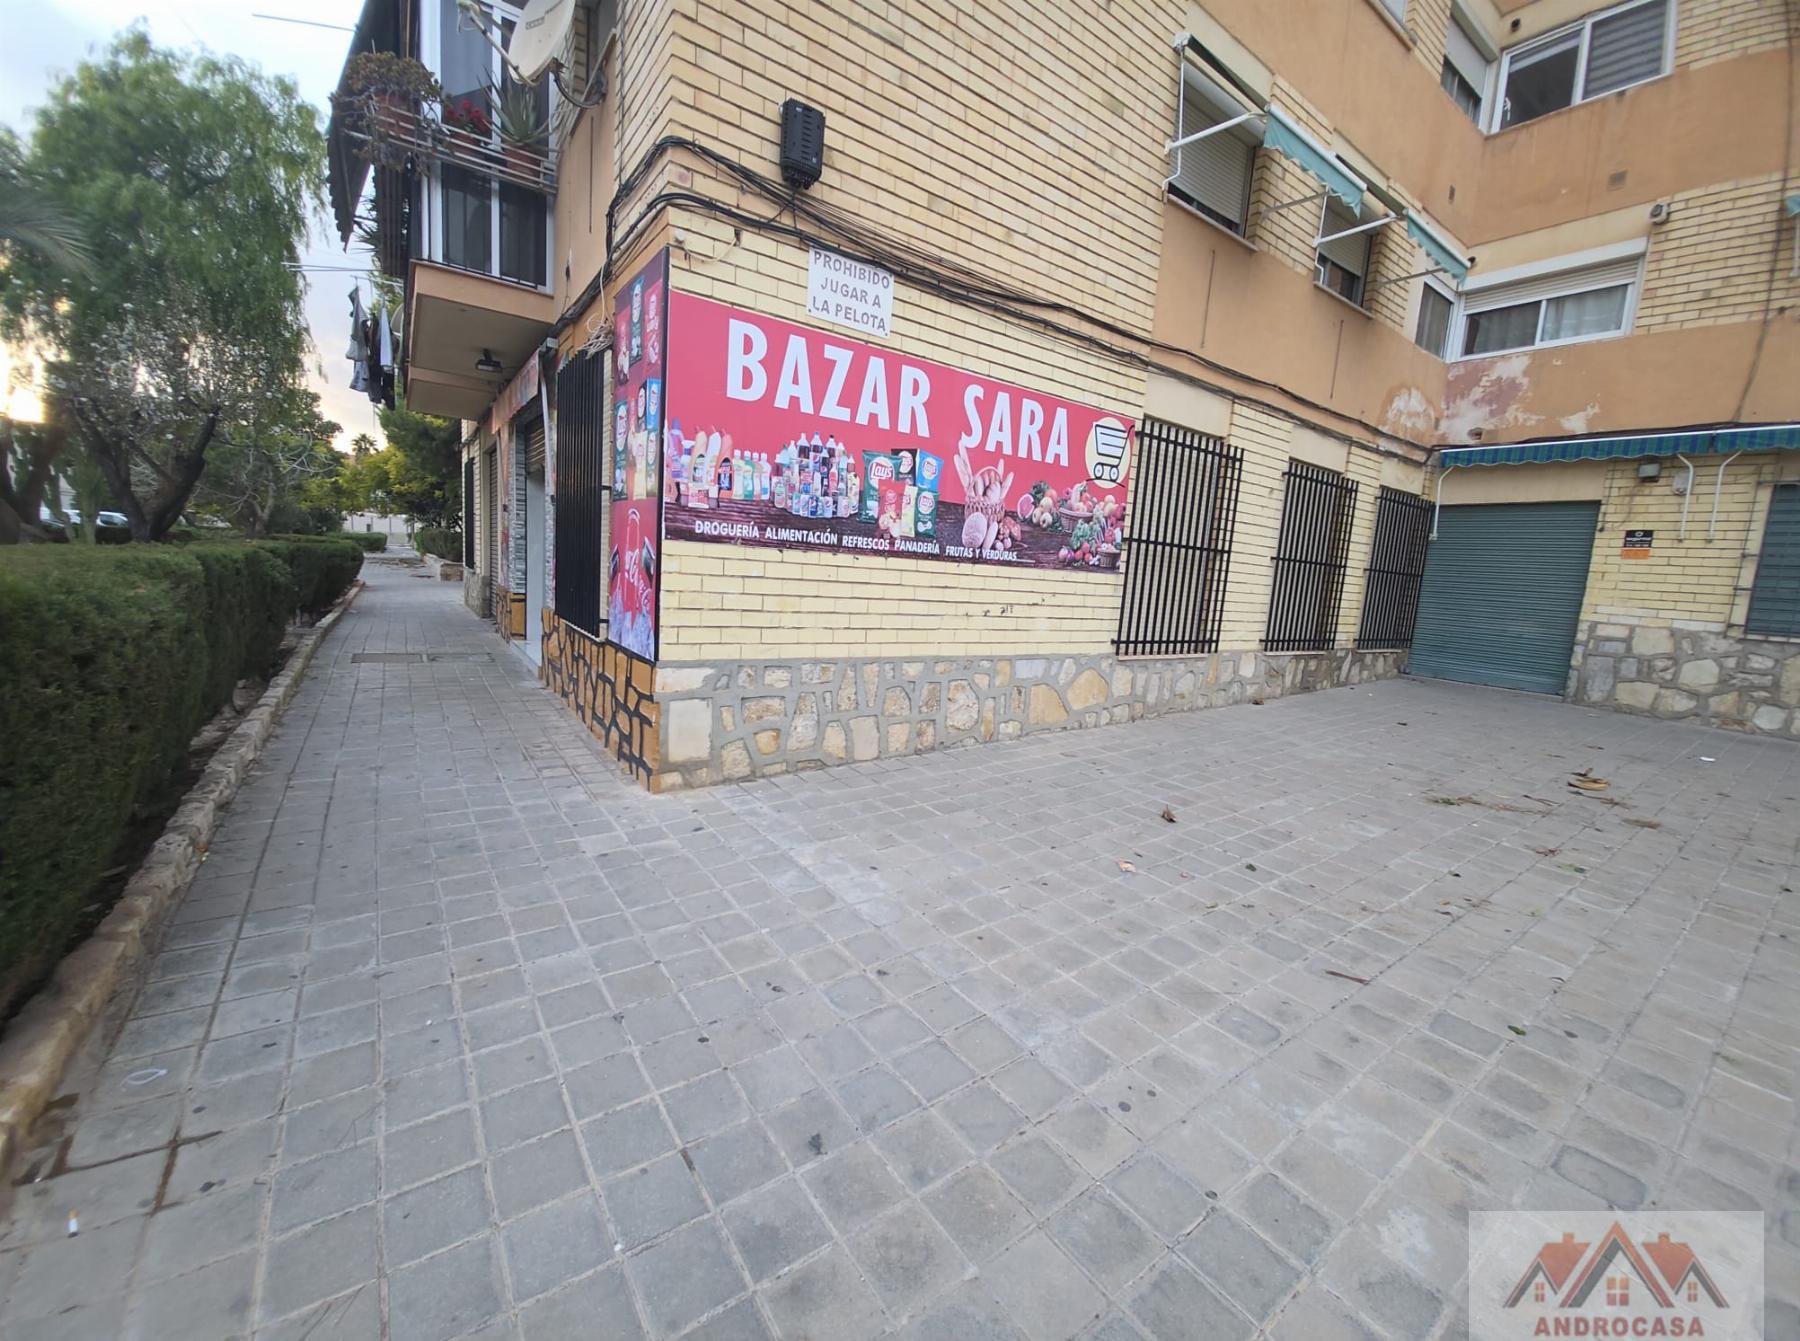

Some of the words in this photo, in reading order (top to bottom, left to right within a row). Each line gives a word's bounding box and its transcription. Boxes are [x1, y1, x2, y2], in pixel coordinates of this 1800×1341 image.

[814, 251, 890, 289] PROHIBIDO
[821, 277, 868, 304] JUGAR
[872, 294, 881, 309] A
[813, 295, 830, 315] LA
[835, 303, 886, 332] PELOTA
[727, 319, 931, 438] BAZAR
[962, 384, 1070, 467] SARA
[694, 520, 759, 539] DROGUERÍA
[764, 527, 838, 545] ALIMENTACIÓN
[842, 535, 890, 550] REFRESCOS
[894, 540, 940, 554] PANADERÍA
[945, 545, 973, 558] FRUTAS
[975, 549, 980, 558] Y
